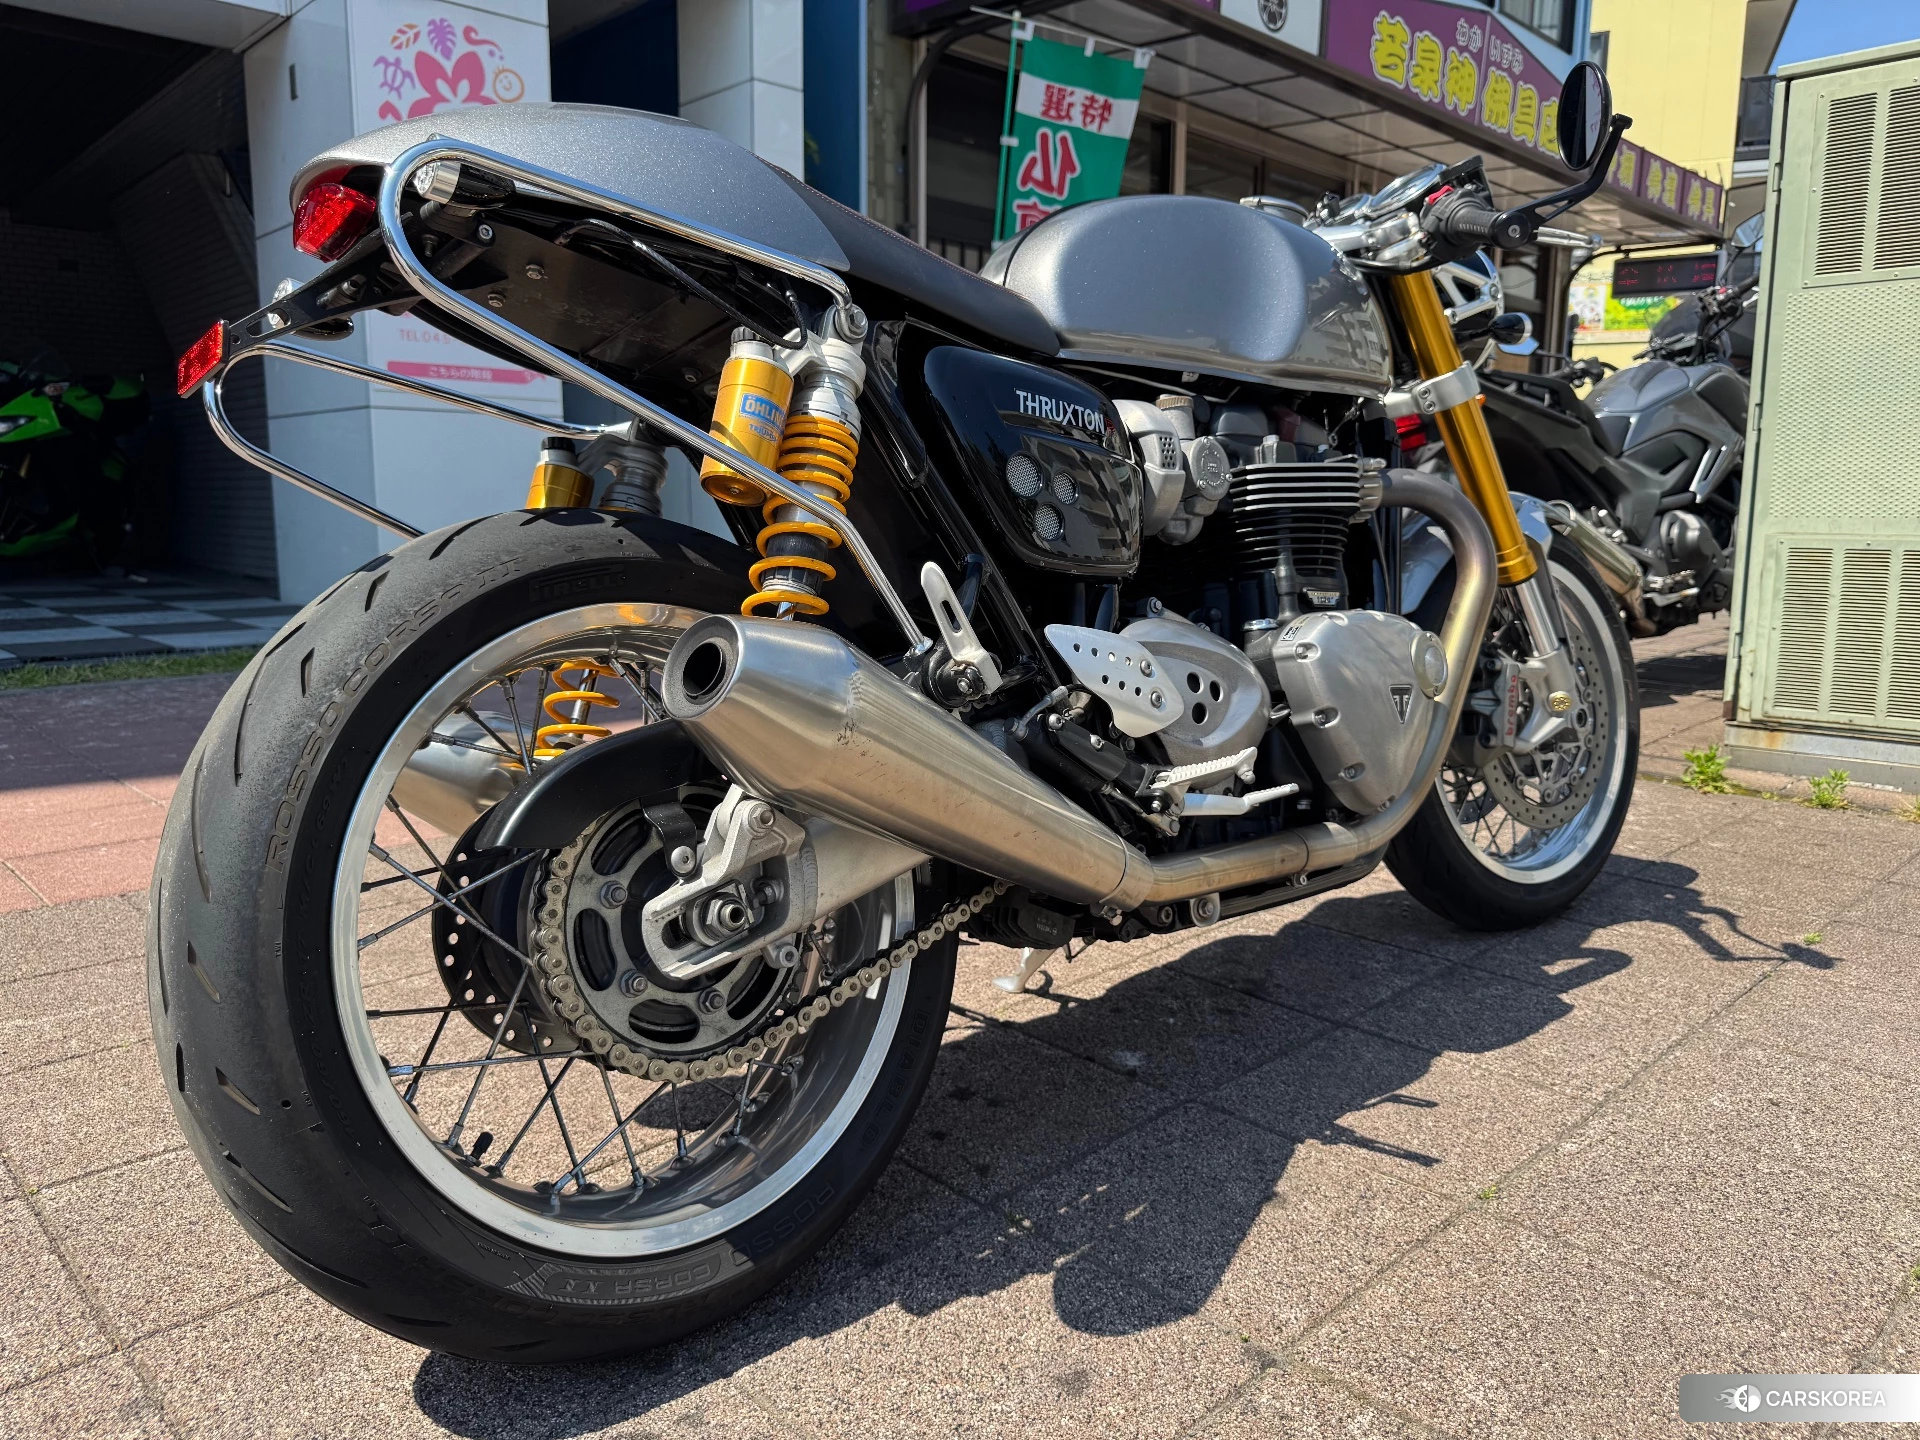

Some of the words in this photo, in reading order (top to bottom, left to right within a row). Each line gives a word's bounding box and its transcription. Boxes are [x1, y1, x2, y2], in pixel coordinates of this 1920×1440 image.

[744, 396, 786, 429] ÖHLIN
[1015, 389, 1106, 434] THRUXTON
[265, 701, 343, 874] ROSSO
[728, 1182, 836, 1267] ROSSO
[614, 1264, 711, 1296] CORSA
